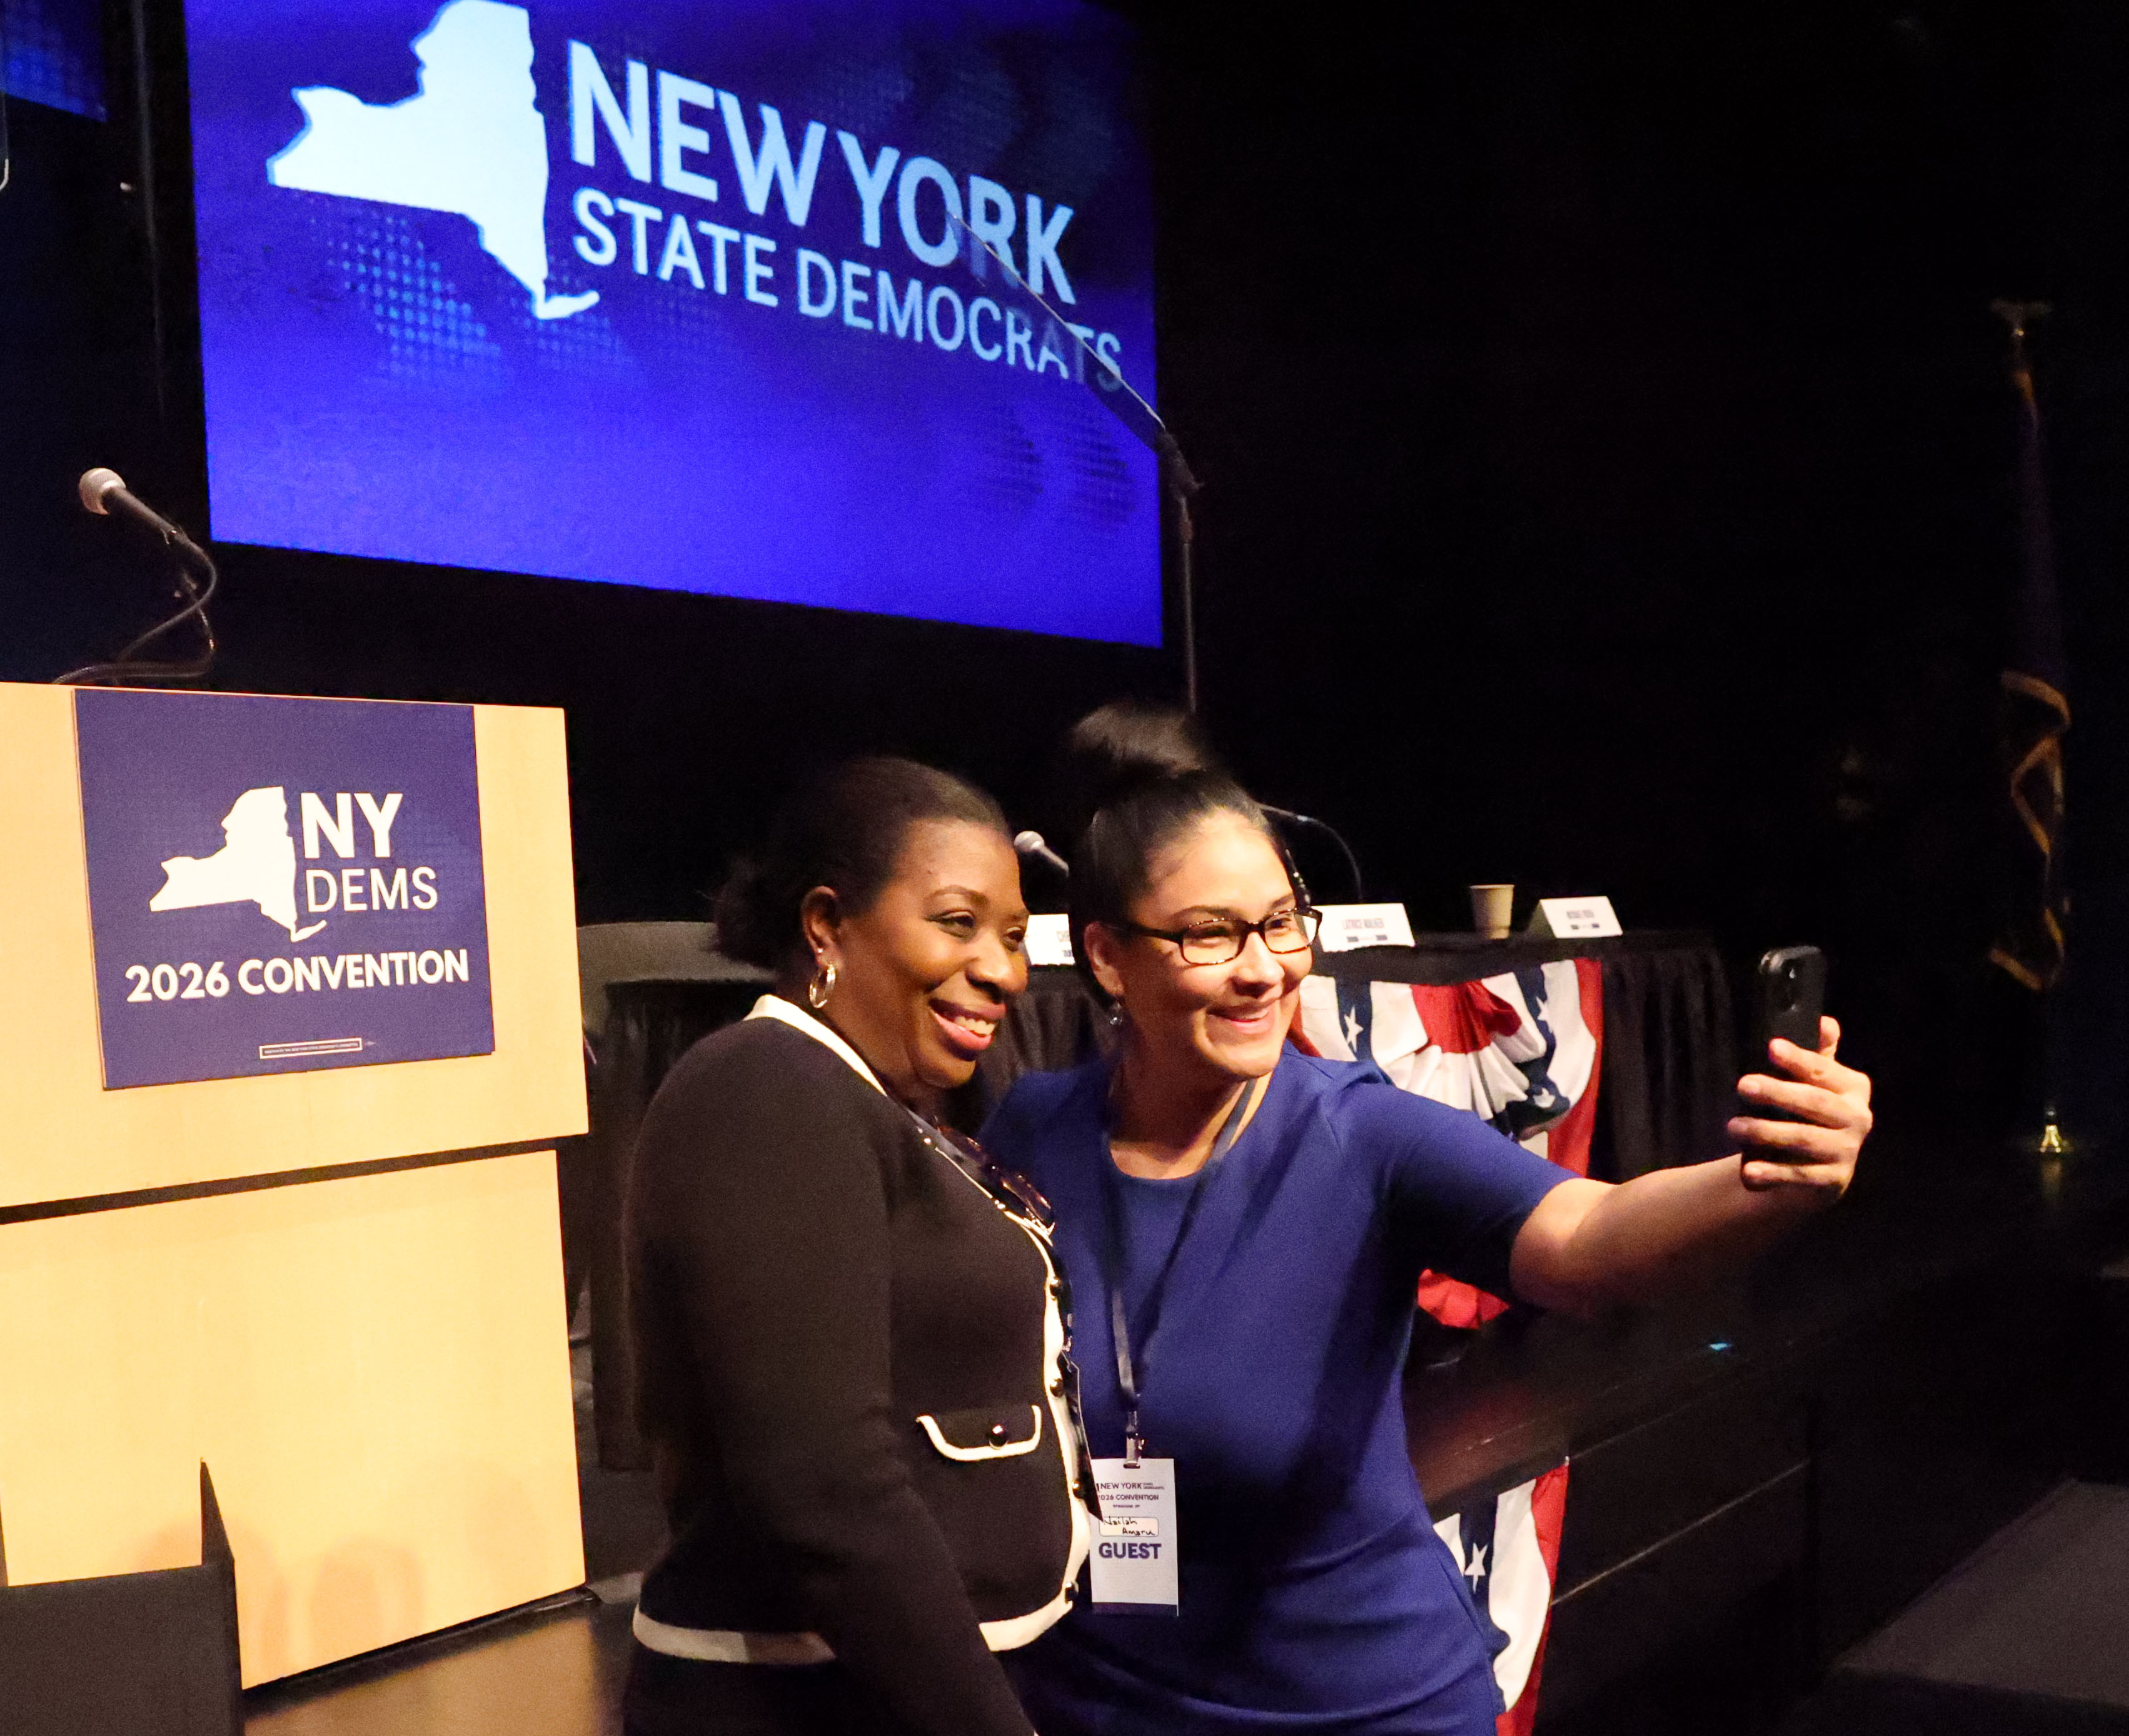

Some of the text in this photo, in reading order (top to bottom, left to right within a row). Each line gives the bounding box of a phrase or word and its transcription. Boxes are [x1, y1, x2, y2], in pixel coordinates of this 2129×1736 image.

[568, 39, 1075, 305] NEW YORK
[573, 186, 1122, 392] STATE DEMOCRATS
[301, 792, 403, 859] NY
[306, 866, 438, 913] DEMS
[125, 949, 469, 1003] 2026 CONVENTION
[1099, 1542, 1162, 1560] GUEST
